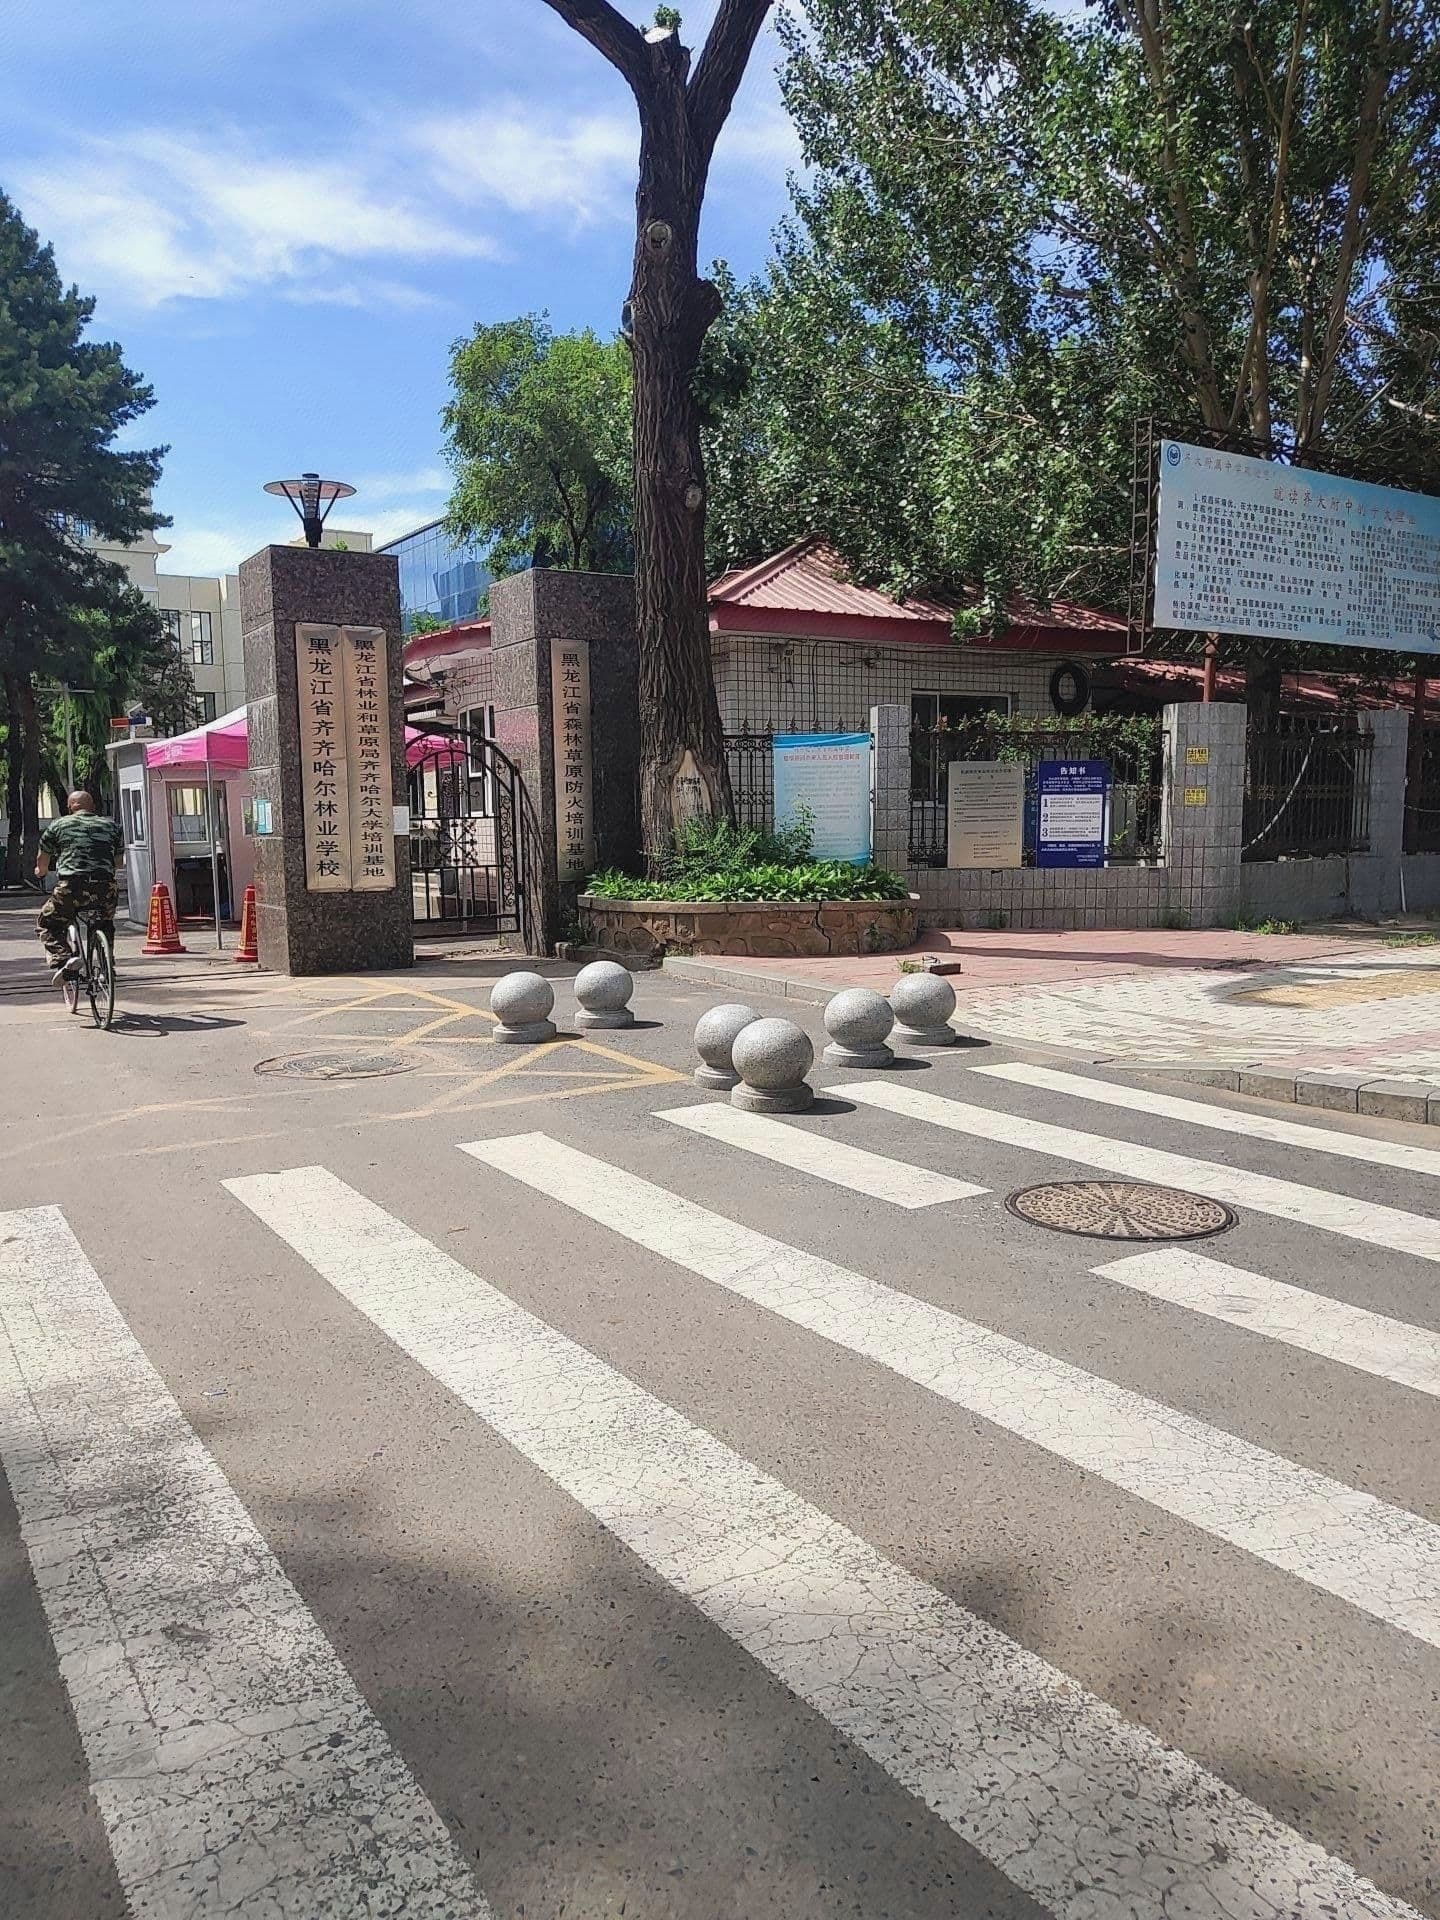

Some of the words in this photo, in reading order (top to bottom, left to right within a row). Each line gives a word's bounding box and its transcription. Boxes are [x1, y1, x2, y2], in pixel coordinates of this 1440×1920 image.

[308, 635, 340, 878] 黑龙江省齐齐哈尔林业学校
[354, 637, 386, 878] 黑龙江省林业和草原局齐齐哈尔大学培训基地
[561, 653, 585, 872] 黑龙江省森林草原防火培训基地
[1061, 767, 1086, 775] 告知书
[1043, 799, 1048, 807] 1
[1042, 813, 1049, 822] 2
[1042, 828, 1048, 837] 3
